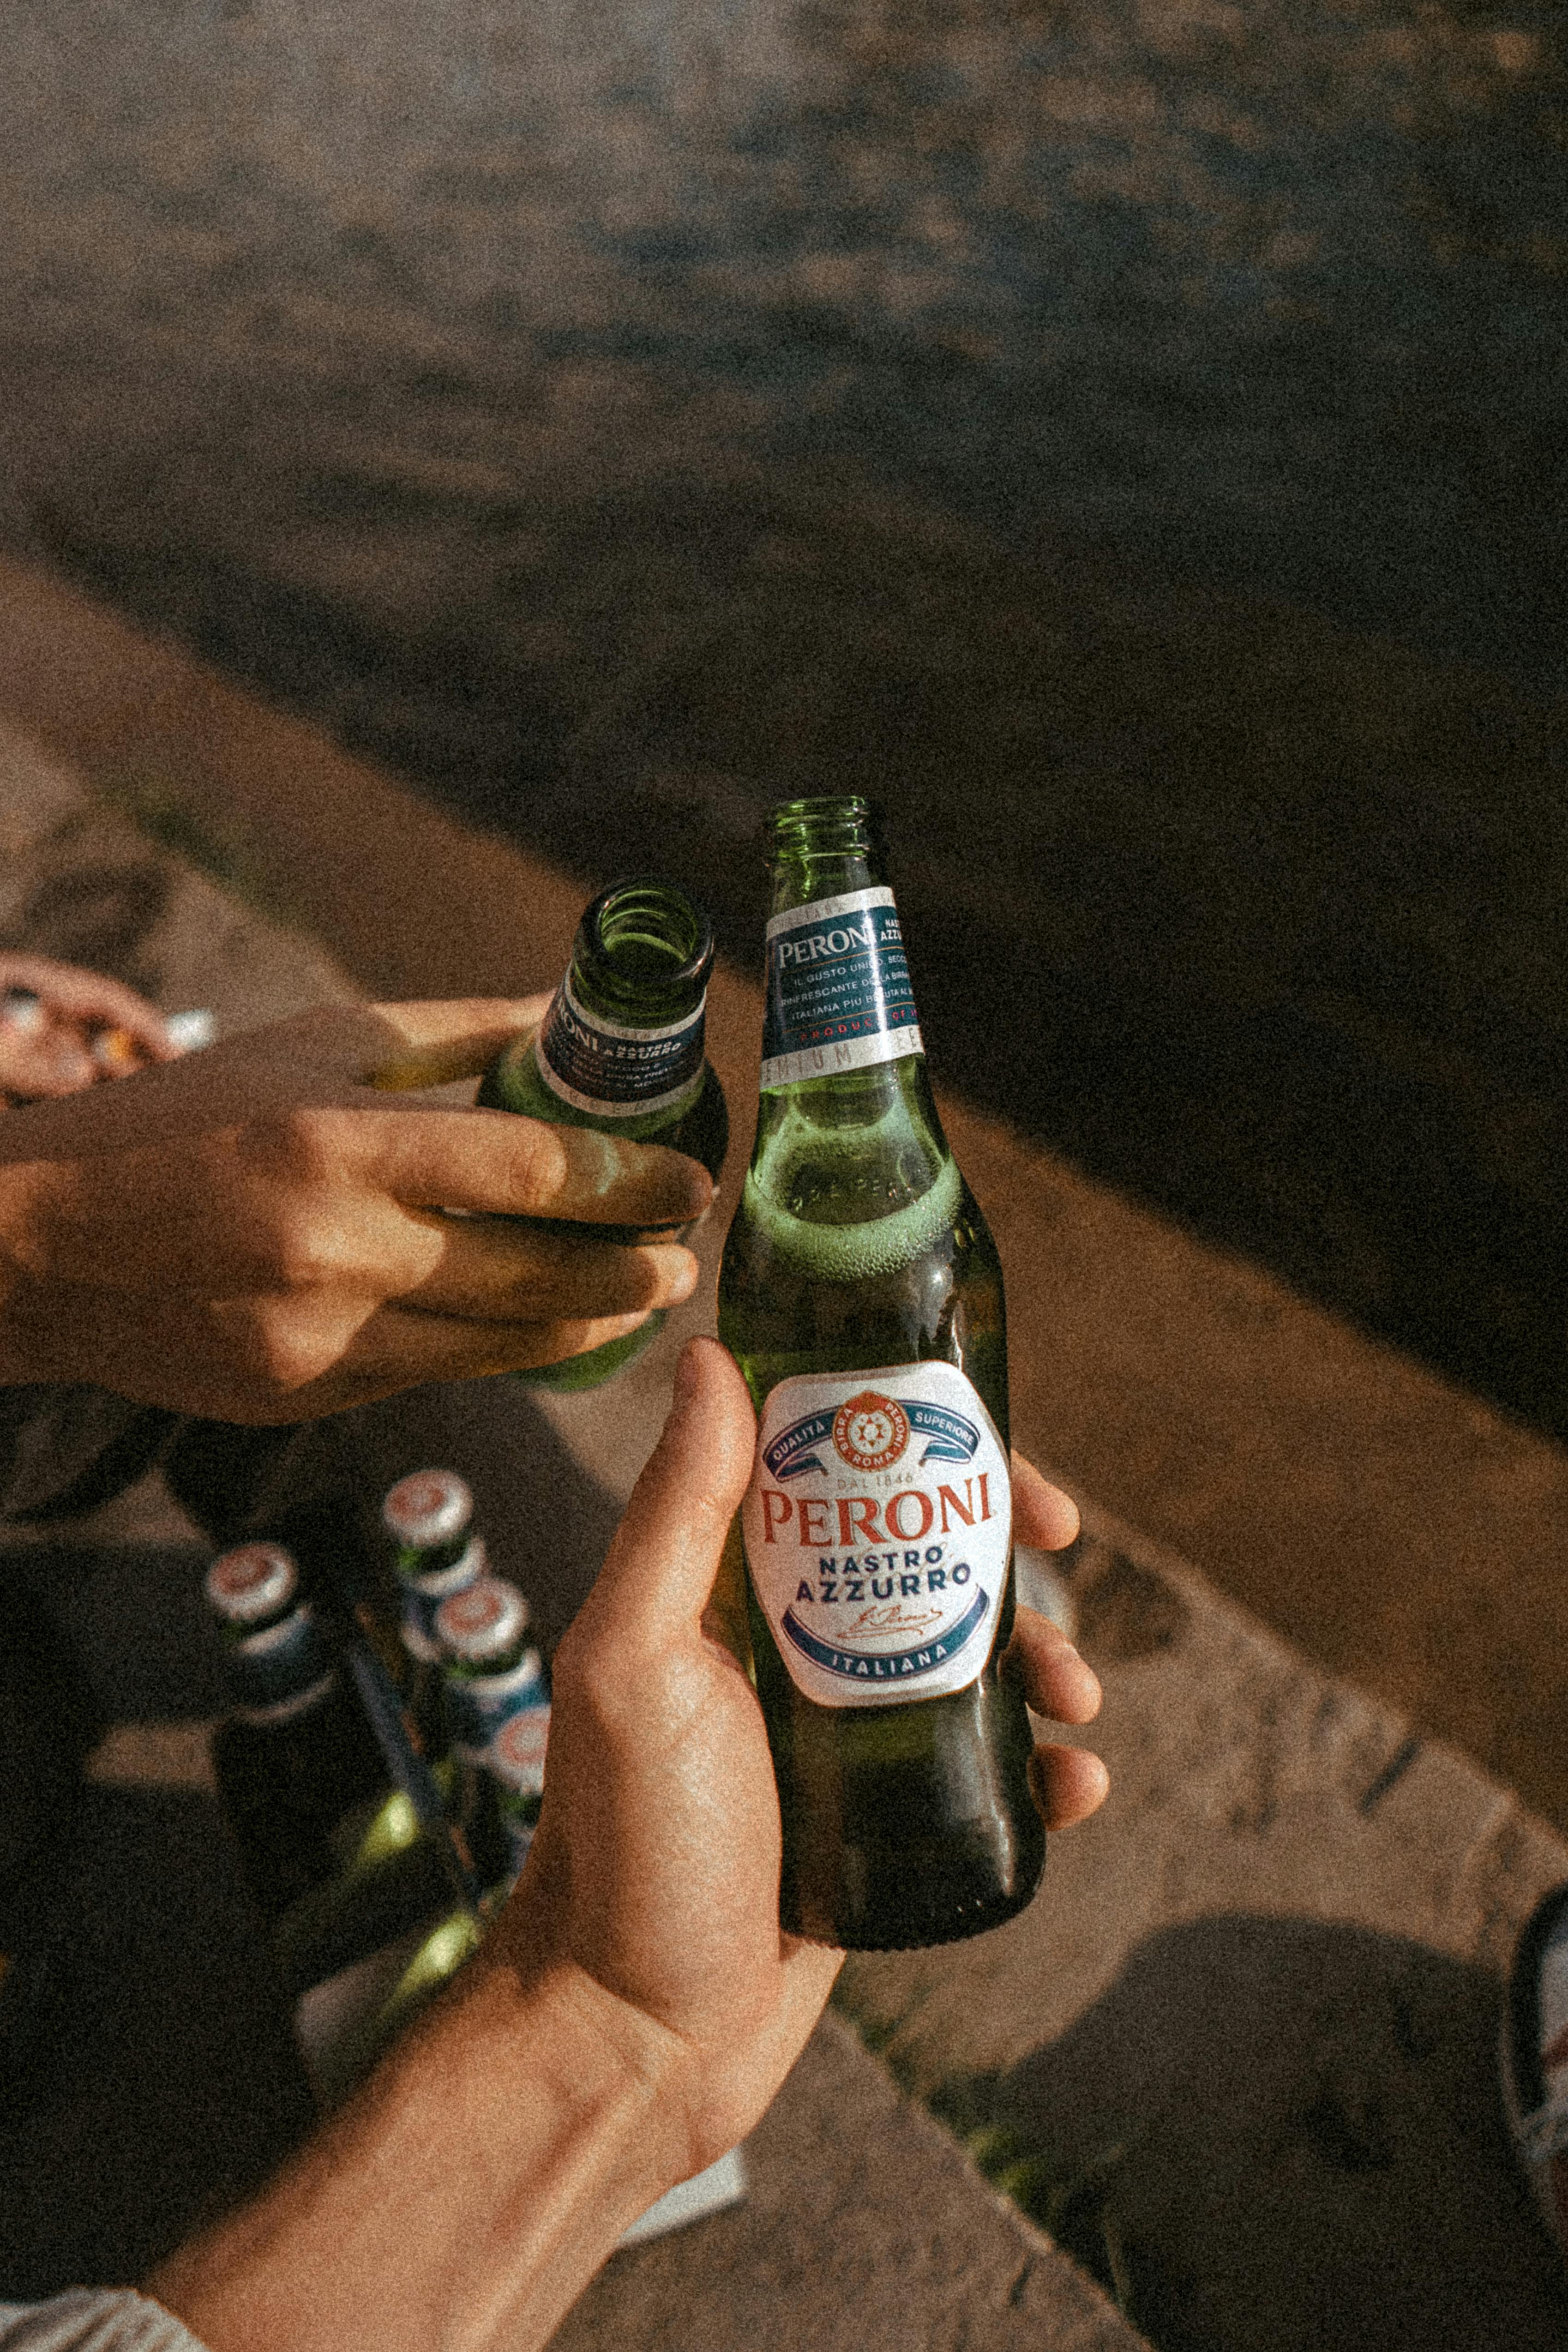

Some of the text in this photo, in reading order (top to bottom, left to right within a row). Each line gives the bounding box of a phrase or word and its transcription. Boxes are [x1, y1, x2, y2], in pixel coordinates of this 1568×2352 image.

[779, 920, 877, 968] PERONI
[806, 967, 847, 983] GUSTO
[781, 981, 858, 1007] RINFRESCANTE
[792, 1003, 840, 1020] ITALIANA
[836, 1402, 905, 1451] BIRRA PERONI
[915, 1411, 974, 1446] SUPERIORE
[853, 1452, 894, 1467] ROMA
[761, 1473, 991, 1547] PERONI
[819, 1546, 943, 1575] NASTRO
[795, 1563, 971, 1603] AZZURRO
[833, 1644, 947, 1676] ITALIANA
